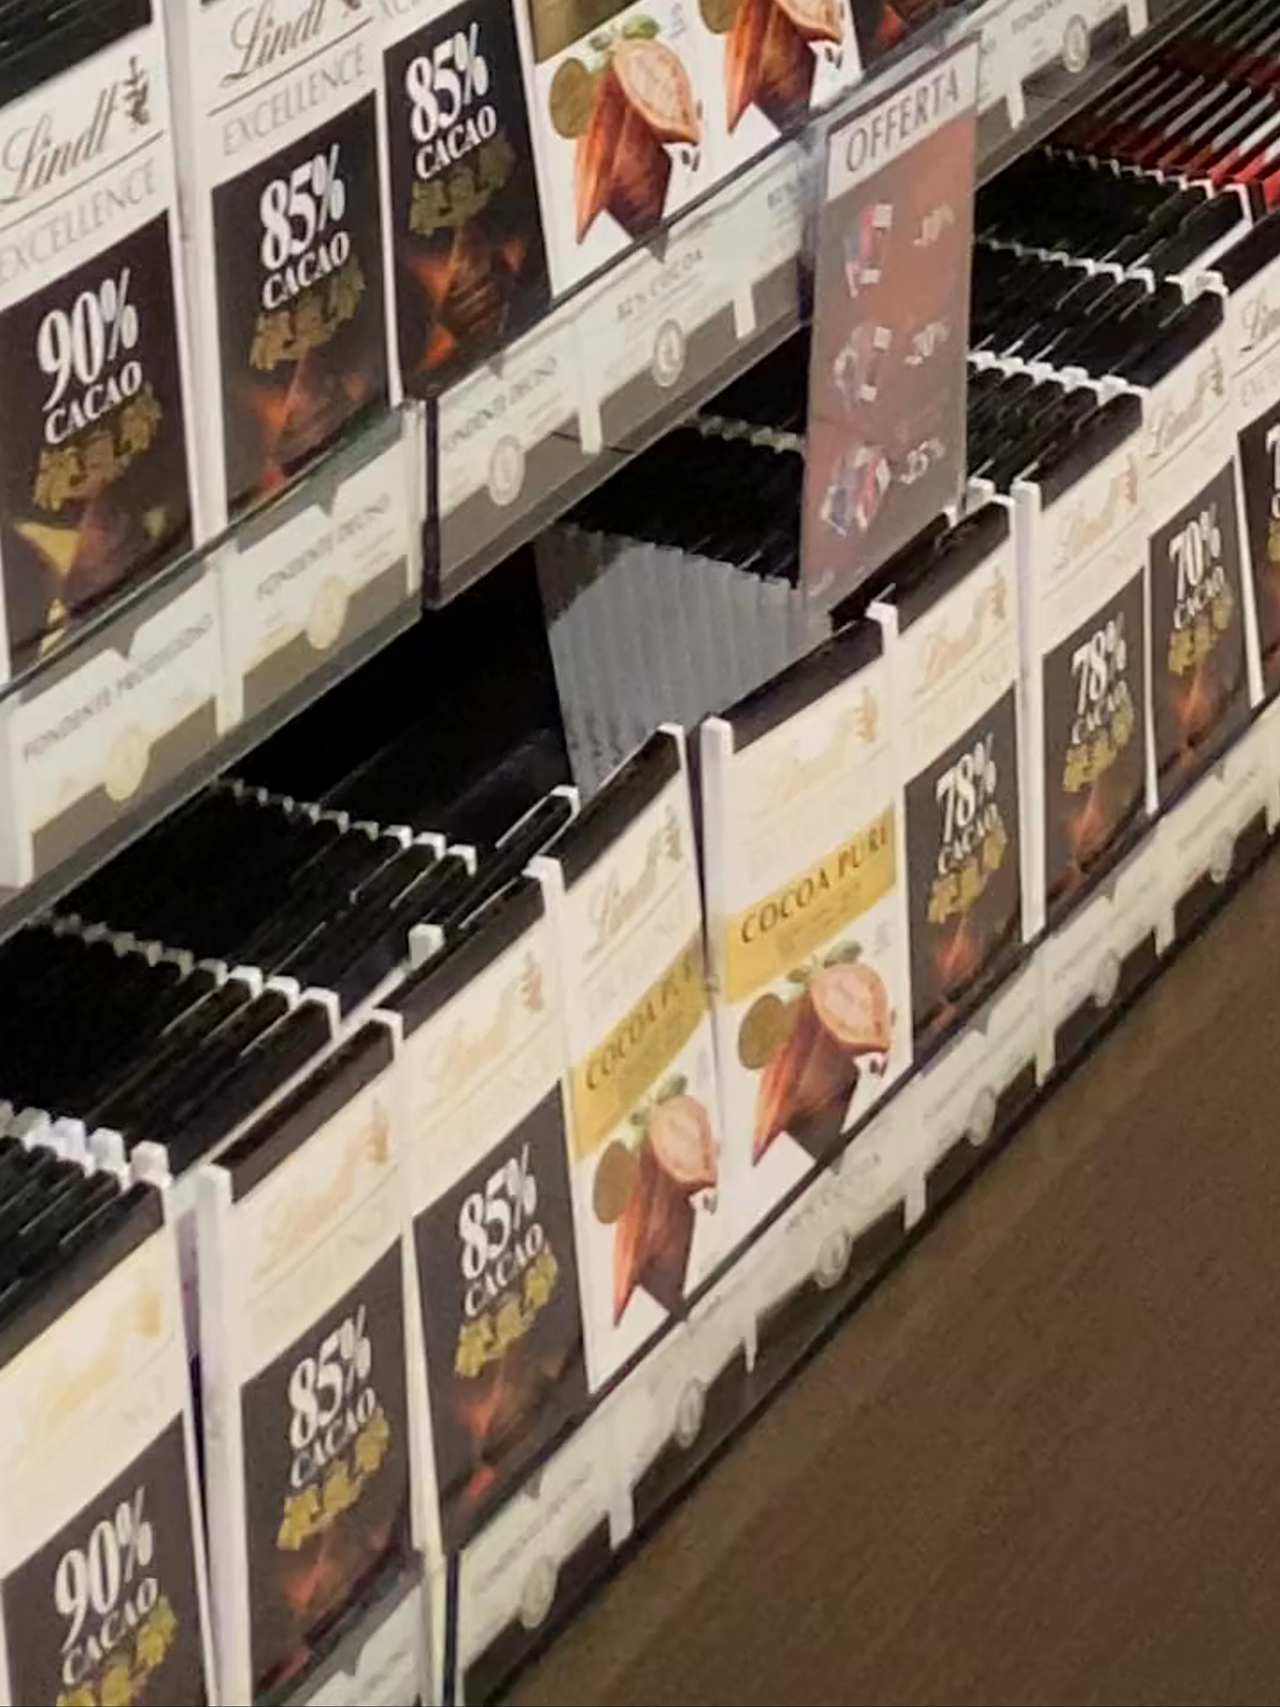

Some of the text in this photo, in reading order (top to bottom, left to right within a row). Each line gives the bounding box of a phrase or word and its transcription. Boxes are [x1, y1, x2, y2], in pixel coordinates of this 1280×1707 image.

[407, 22, 491, 144] 85%
[844, 67, 961, 177] OFFERTA
[260, 142, 345, 271] 85%
[38, 269, 139, 411] 90%
[45, 357, 143, 447] CACAO
[935, 731, 996, 833] 78%
[738, 866, 830, 946] COCOA
[459, 1143, 538, 1282] 85%
[287, 1304, 373, 1451] 85%
[54, 1486, 153, 1652] 90%
